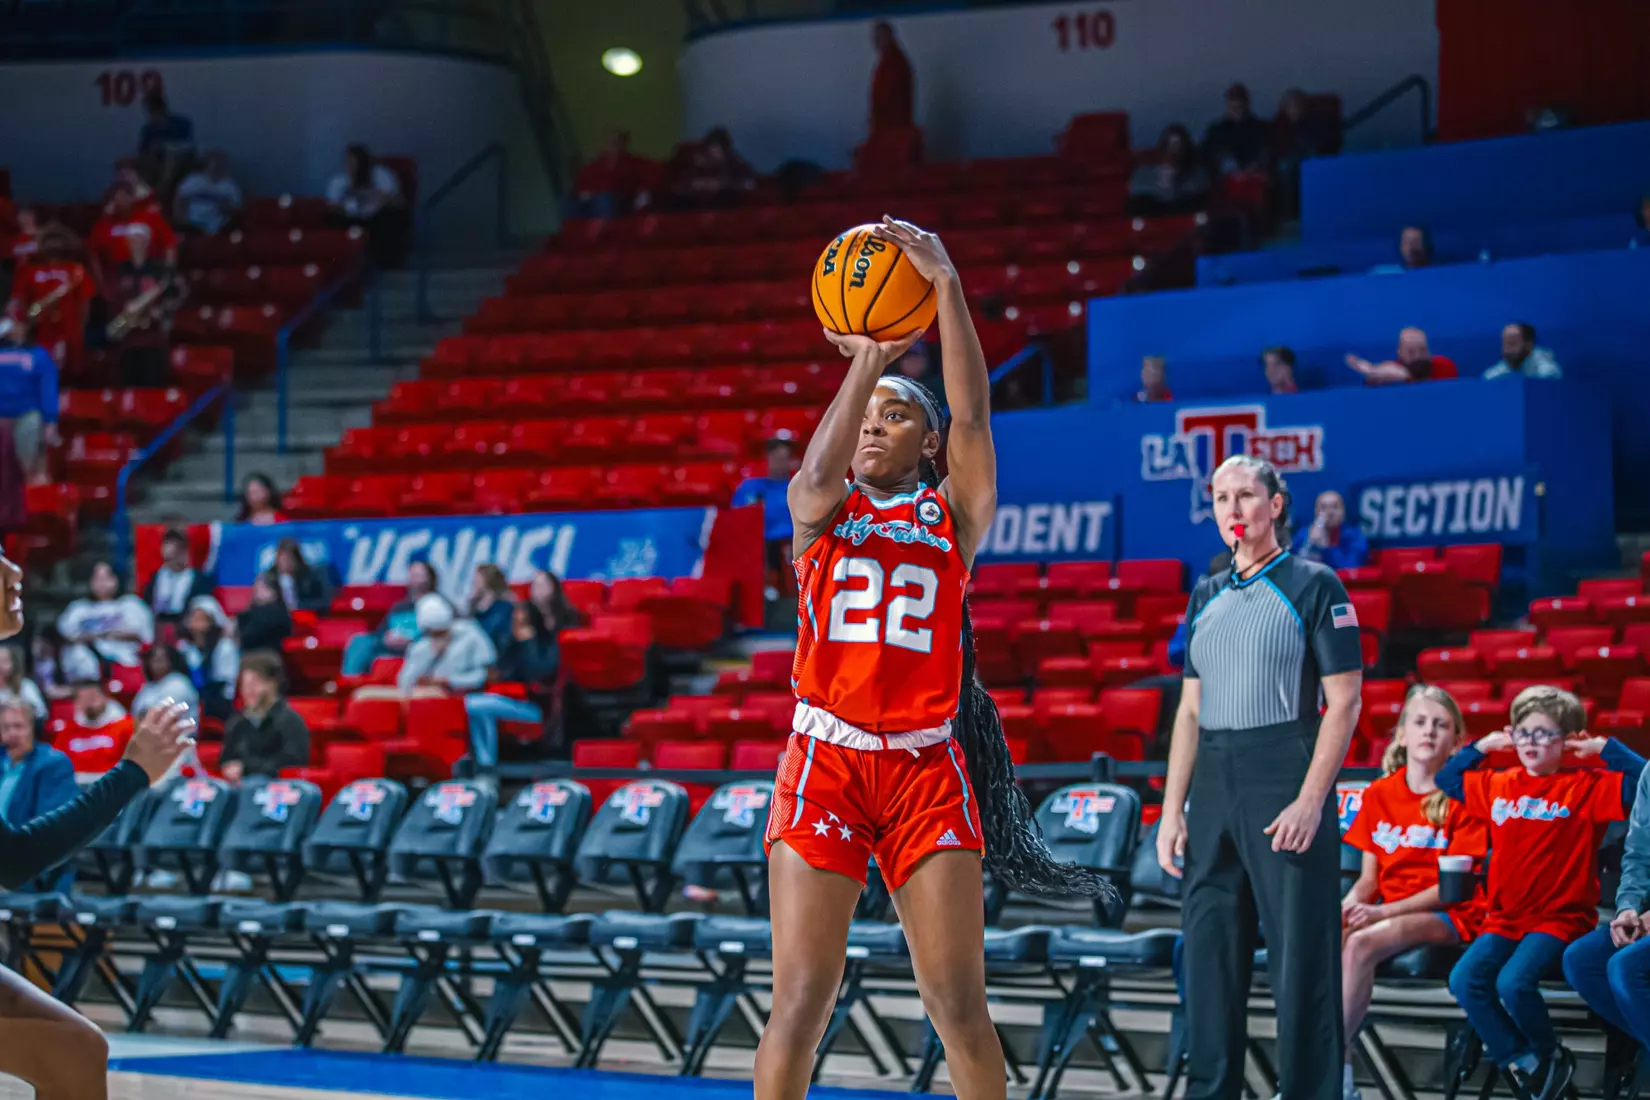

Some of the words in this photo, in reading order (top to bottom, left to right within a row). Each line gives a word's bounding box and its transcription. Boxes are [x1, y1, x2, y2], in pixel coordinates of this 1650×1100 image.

[1052, 10, 1116, 51] 110
[822, 235, 846, 277] CAA
[1359, 475, 1525, 538] SECTION
[828, 556, 938, 654] 22
